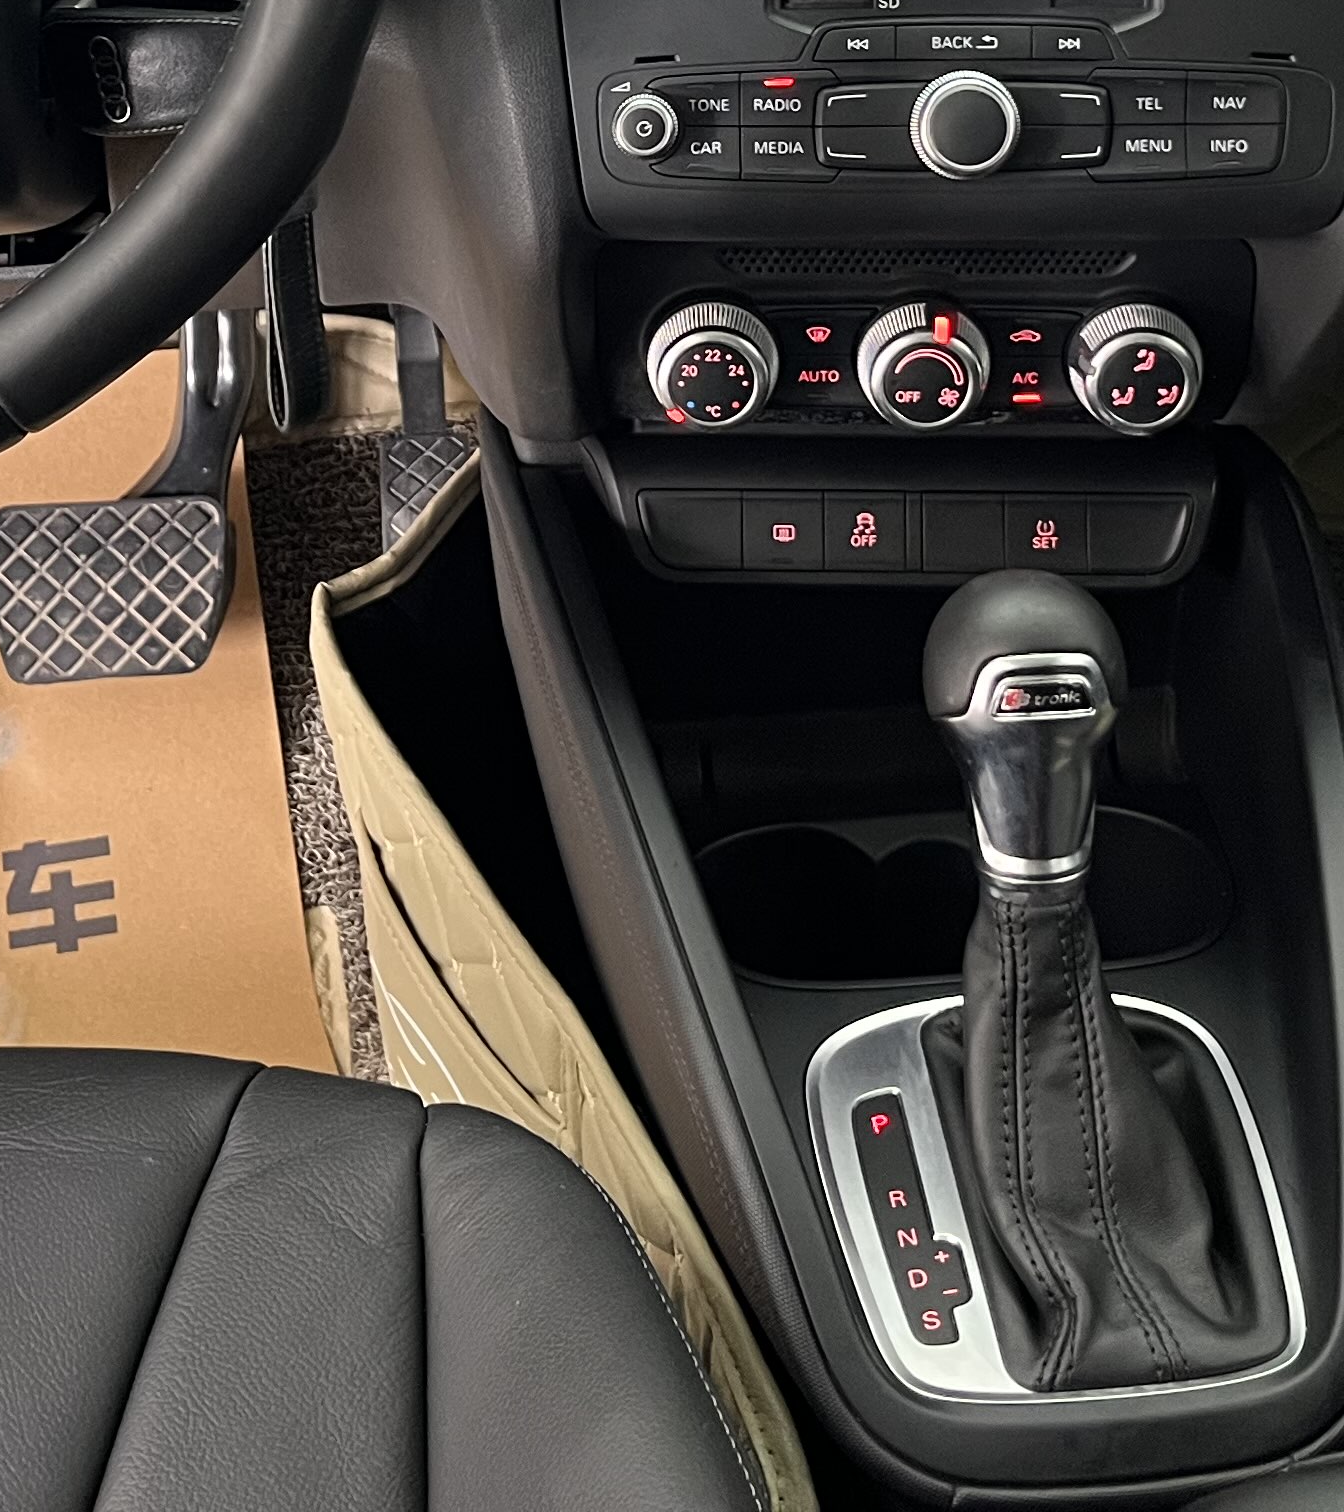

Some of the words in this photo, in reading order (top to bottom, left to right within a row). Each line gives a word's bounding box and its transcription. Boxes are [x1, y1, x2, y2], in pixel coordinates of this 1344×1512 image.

[931, 35, 974, 49] BACK
[689, 98, 730, 112] TONE
[753, 98, 802, 112] RADIO
[1135, 96, 1163, 111] TEL
[1213, 96, 1247, 110] NAV
[690, 141, 722, 155] CAR
[754, 141, 805, 155] MEDIA
[1125, 138, 1173, 153] MENU
[1210, 139, 1249, 153] INFO
[704, 348, 721, 362] 22
[681, 364, 699, 378] 20
[728, 364, 745, 377] 24
[798, 369, 840, 383] AUTO
[1012, 371, 1039, 385] A/C
[894, 390, 921, 403] OFF
[850, 534, 878, 548] OFF
[1032, 536, 1059, 550] SET
[1034, 691, 1081, 706] tronic
[870, 1114, 889, 1134] P
[888, 1190, 908, 1209] R
[897, 1227, 918, 1248] N
[907, 1268, 928, 1289] D
[922, 1311, 941, 1329] S
